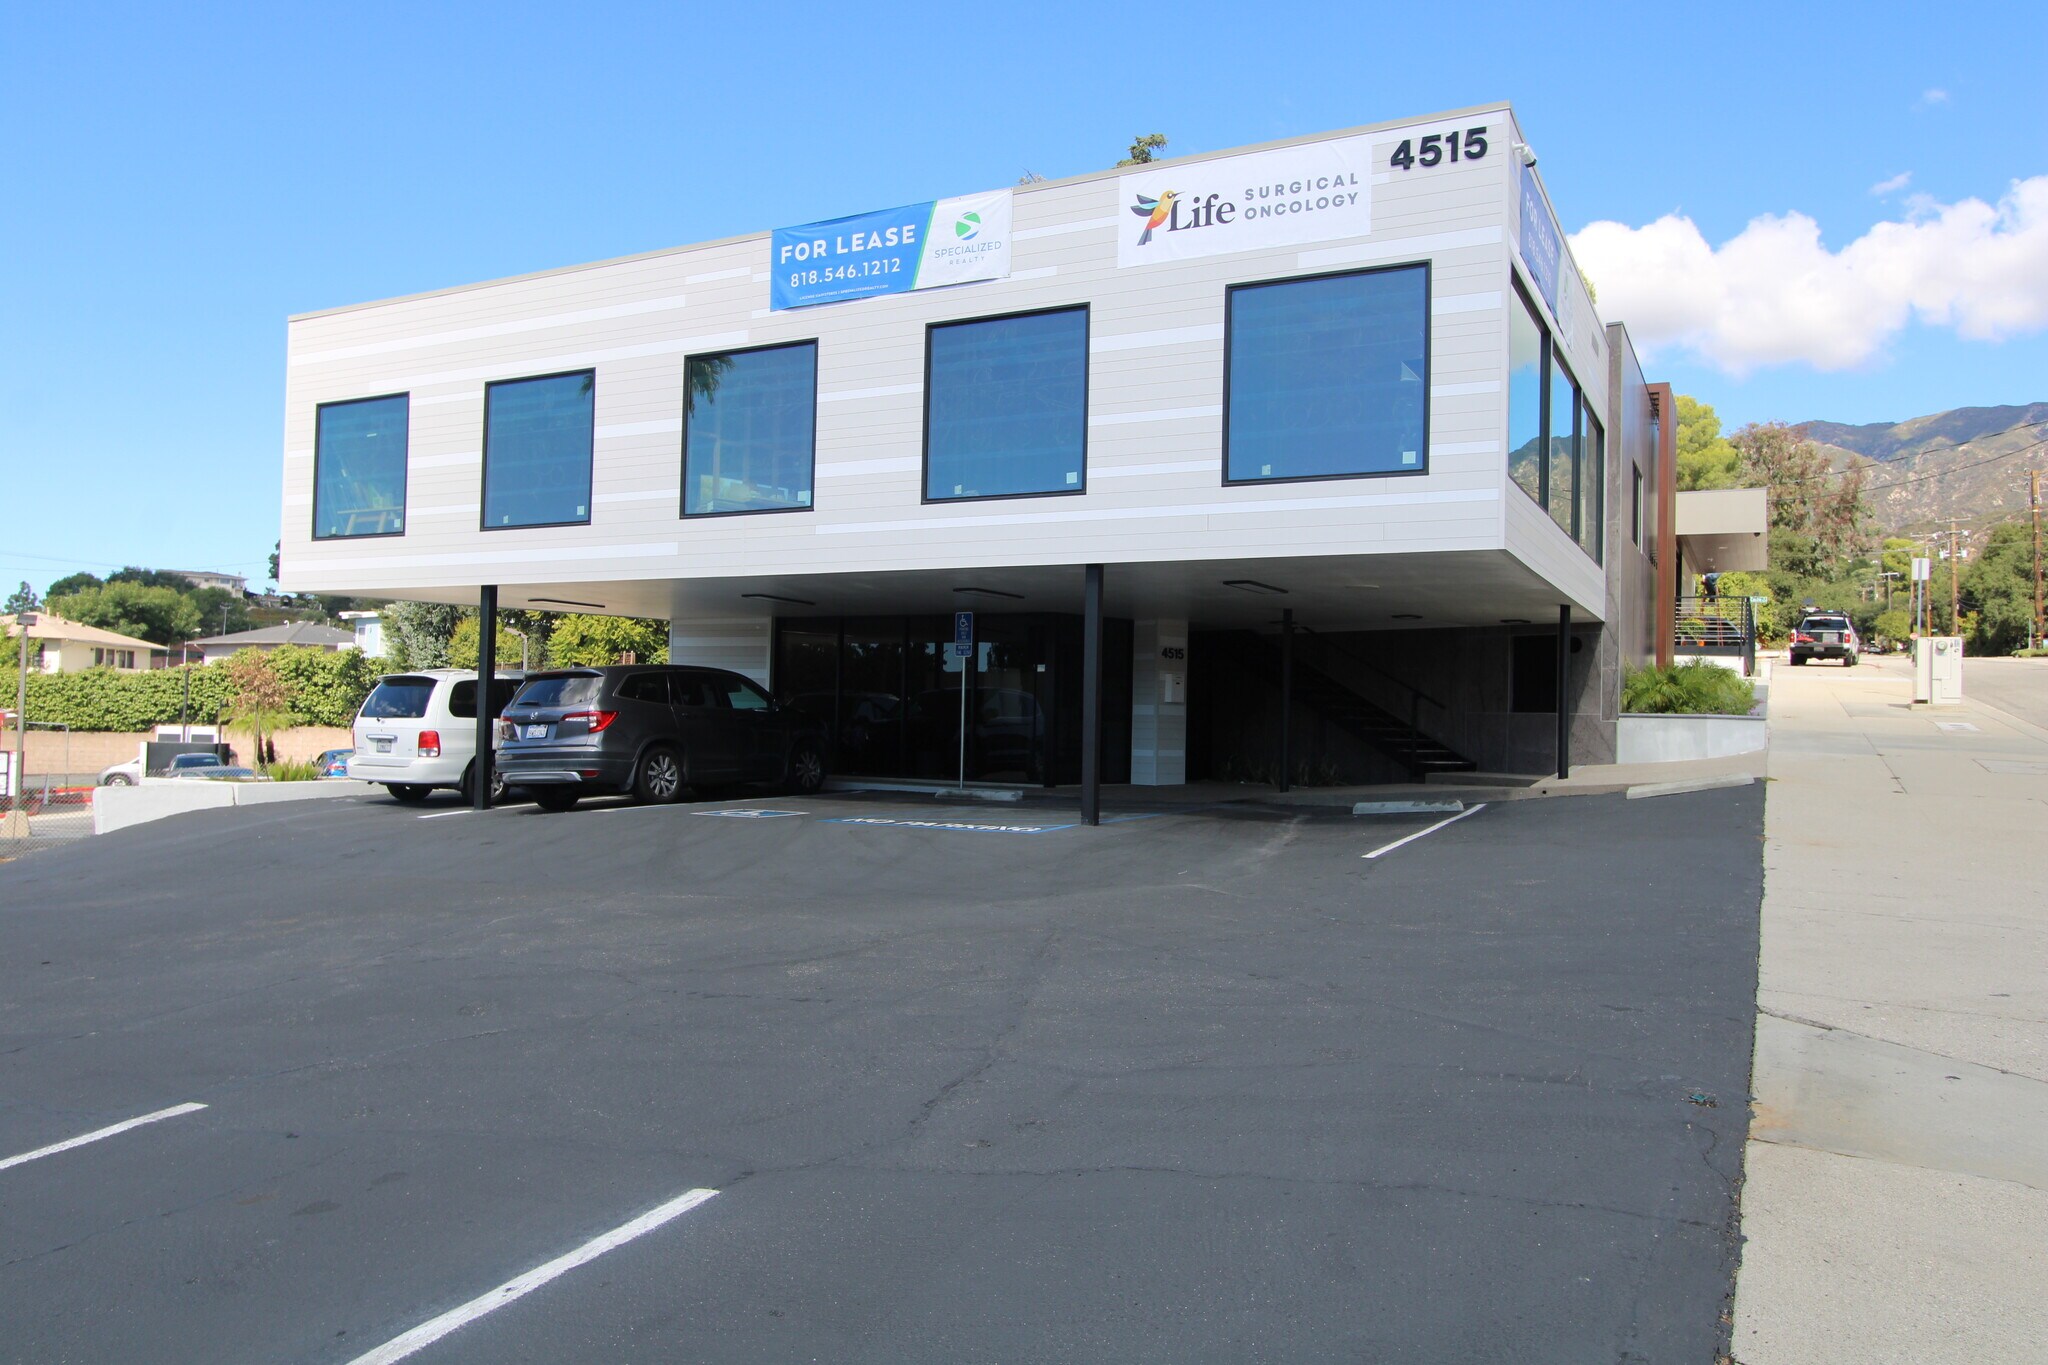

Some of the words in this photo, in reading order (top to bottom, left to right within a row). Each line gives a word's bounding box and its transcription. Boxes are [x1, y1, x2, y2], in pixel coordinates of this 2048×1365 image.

[1390, 126, 1488, 170] 4515
[1244, 173, 1358, 201] SURGICAL
[1167, 193, 1236, 232] Life
[1244, 192, 1359, 220] ONCOLOGY
[781, 239, 827, 264] FOR
[836, 224, 916, 255] LEASE
[934, 240, 1002, 259] SPECIALIZED
[790, 257, 901, 288] 818.546.1212
[949, 256, 985, 265] REALTY
[1161, 647, 1185, 660] 4515
